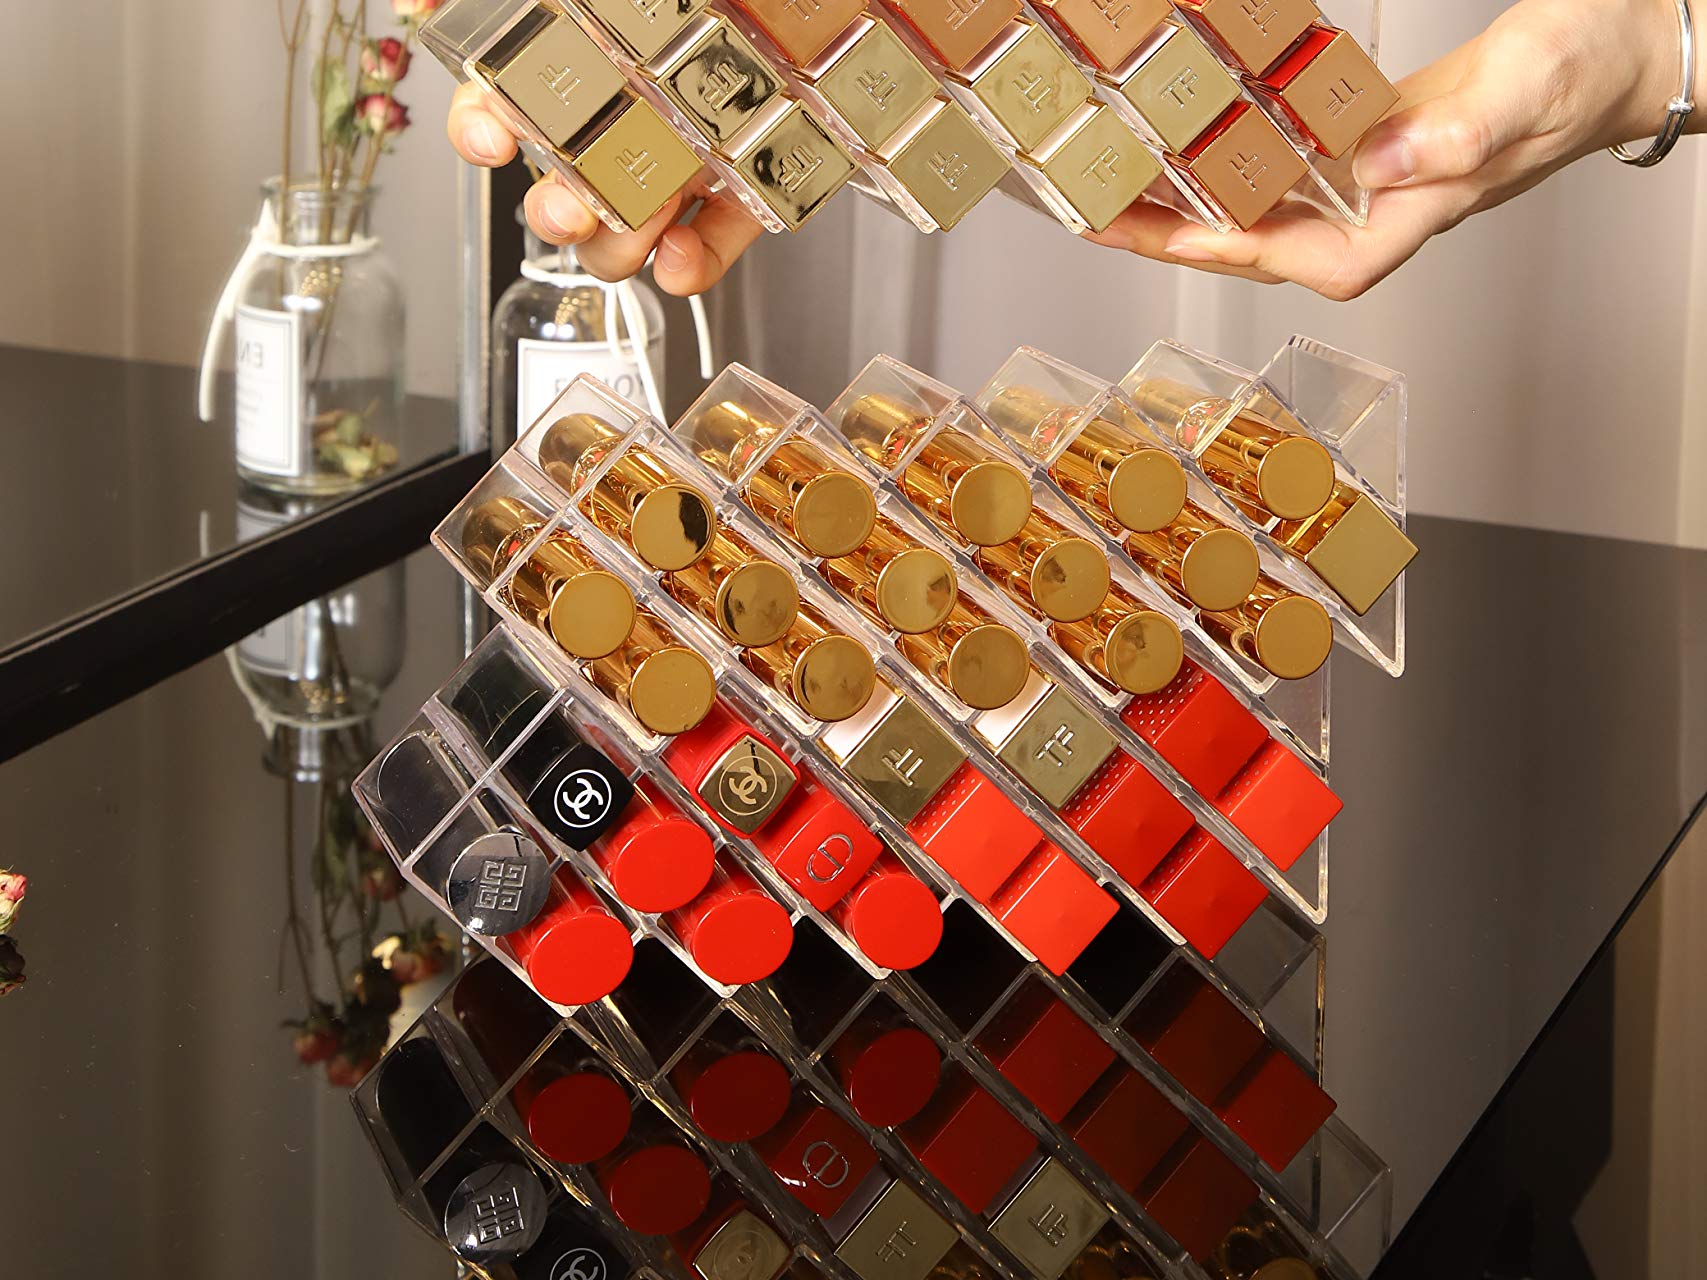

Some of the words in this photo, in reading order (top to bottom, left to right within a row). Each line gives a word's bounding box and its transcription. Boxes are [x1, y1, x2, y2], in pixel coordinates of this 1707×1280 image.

[537, 64, 580, 106] TF
[1160, 67, 1198, 109] TF
[1327, 78, 1365, 119] TF
[615, 148, 658, 190] TF
[1081, 146, 1119, 187] TF
[1229, 152, 1267, 192] TF
[1032, 724, 1075, 768] TF
